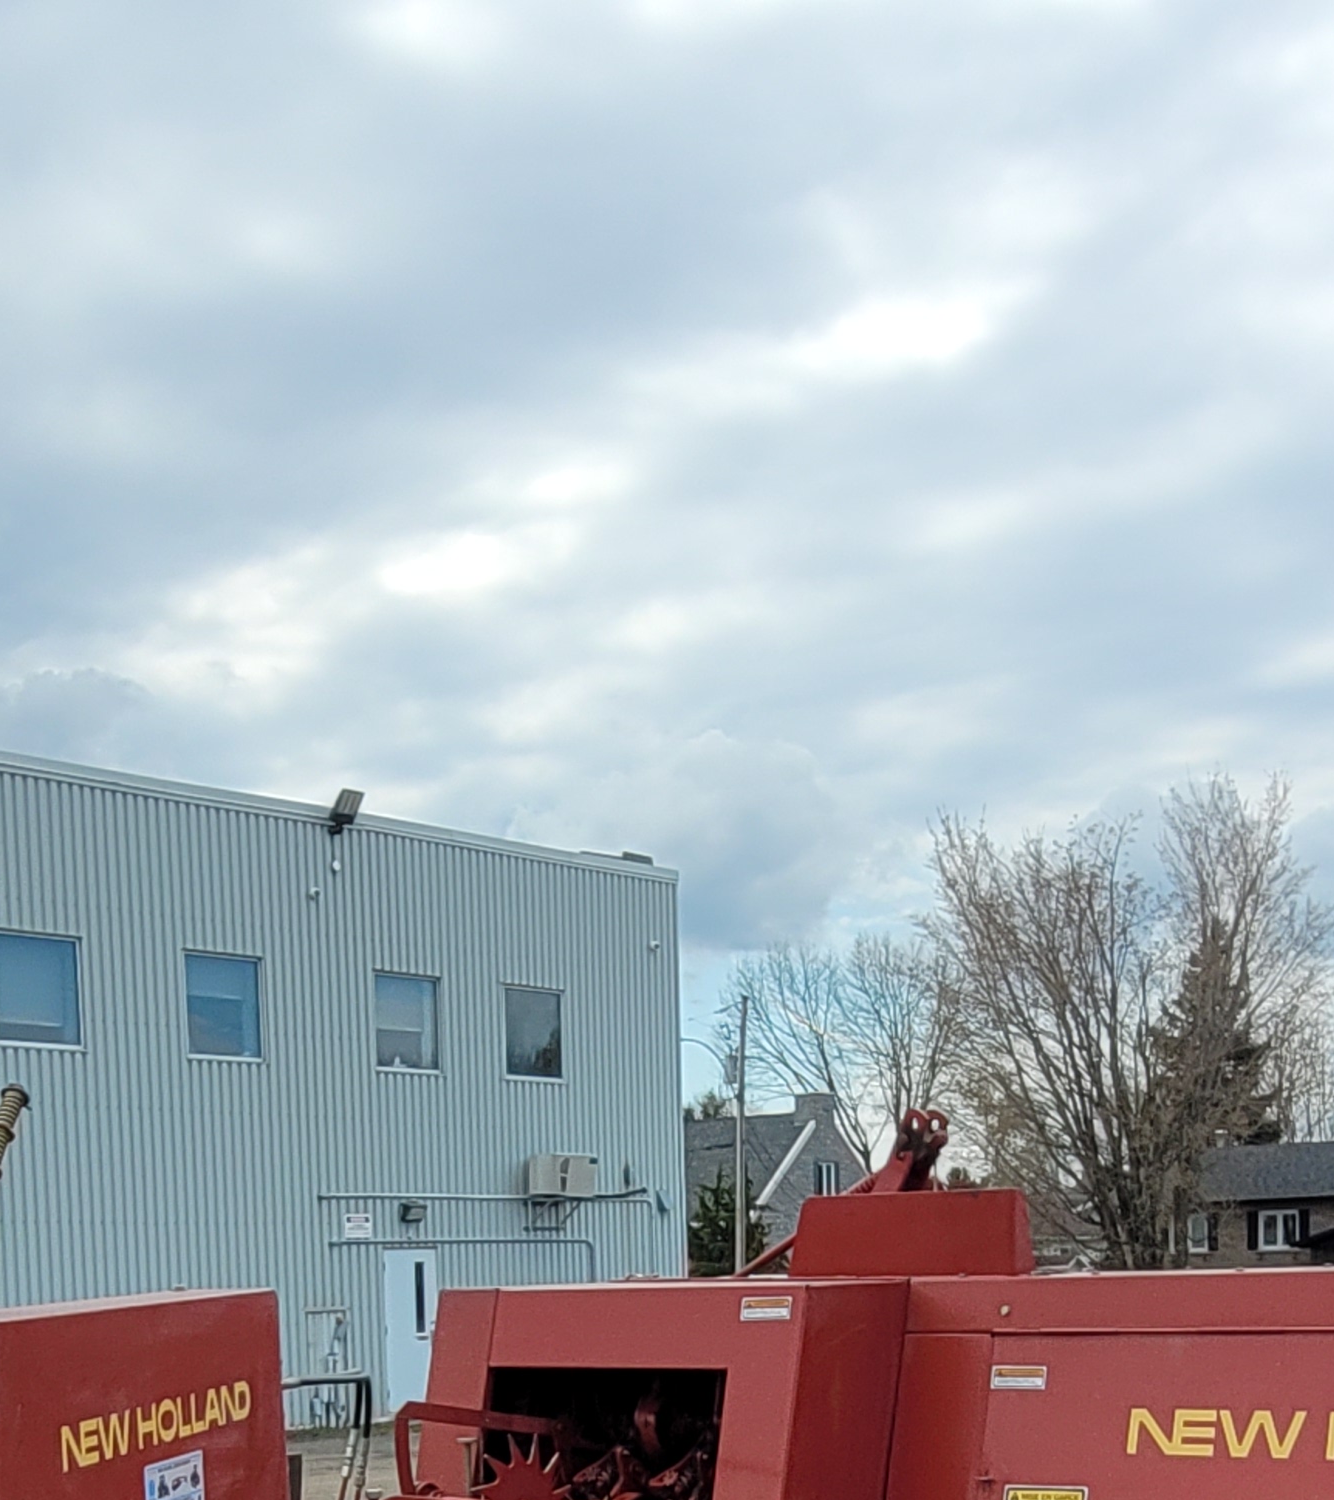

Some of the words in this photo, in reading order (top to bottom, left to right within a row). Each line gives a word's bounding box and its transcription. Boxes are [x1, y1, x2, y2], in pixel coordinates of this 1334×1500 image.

[60, 1408, 131, 1474] NEW
[136, 1380, 252, 1450] HOLLAND
[1126, 1408, 1307, 1459] NEW
